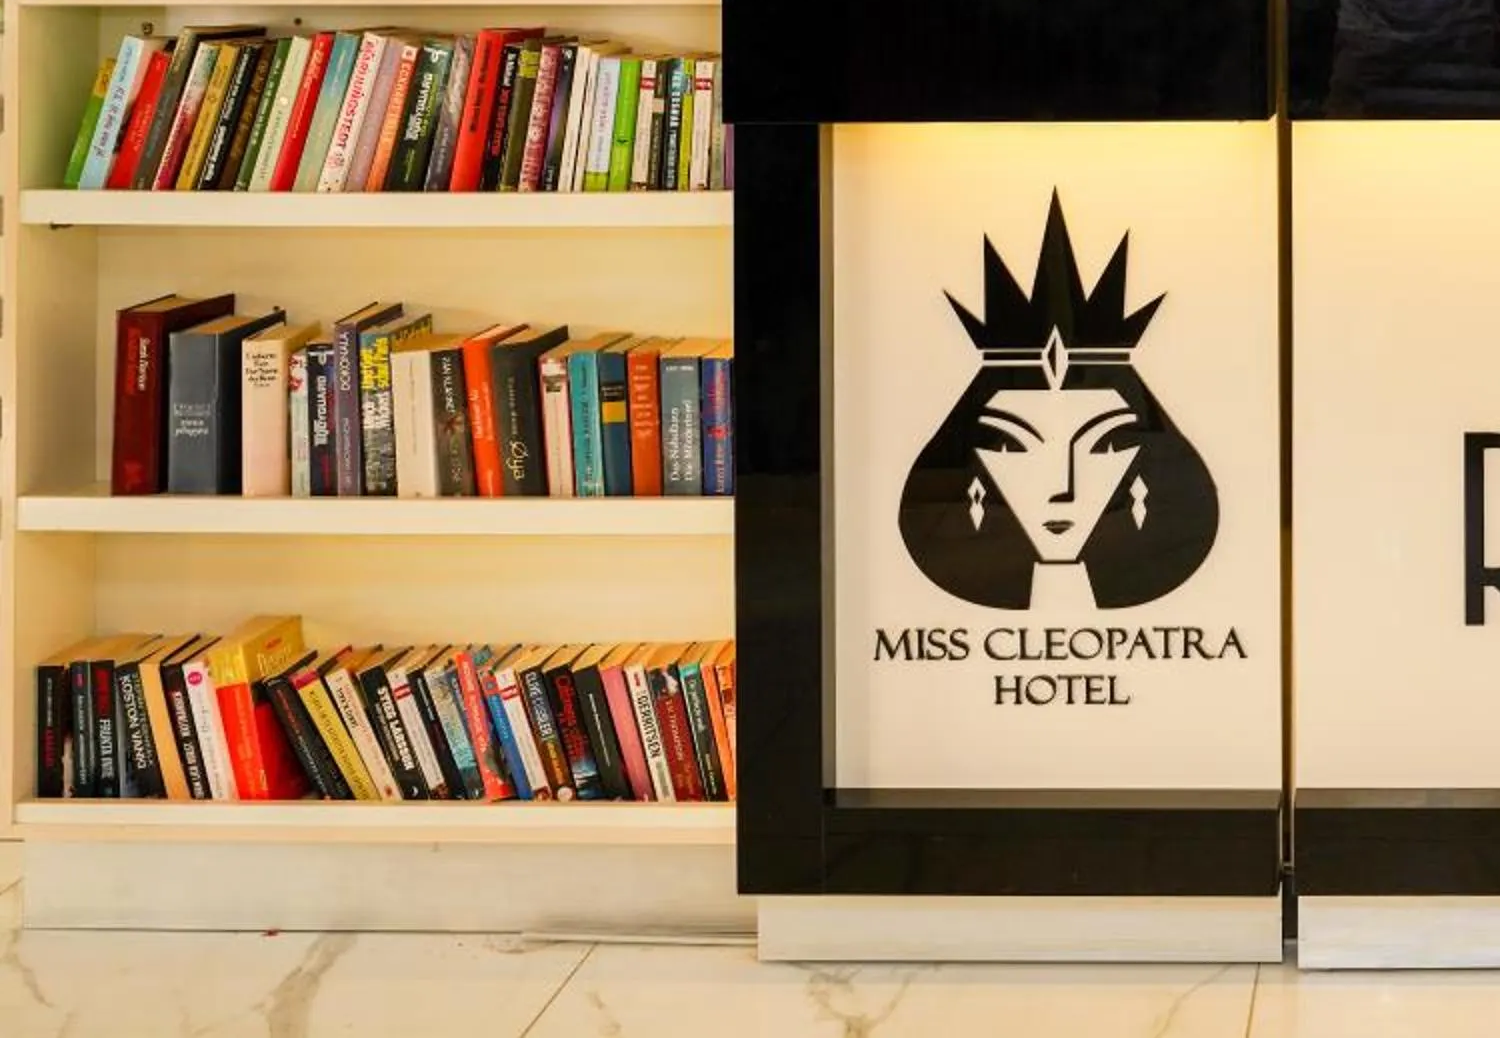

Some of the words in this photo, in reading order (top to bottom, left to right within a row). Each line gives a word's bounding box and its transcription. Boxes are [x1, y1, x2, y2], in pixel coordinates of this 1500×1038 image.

[873, 627, 971, 662] MISS
[984, 627, 1248, 661] CLEOPATRA
[994, 674, 1131, 706] HOTEL
